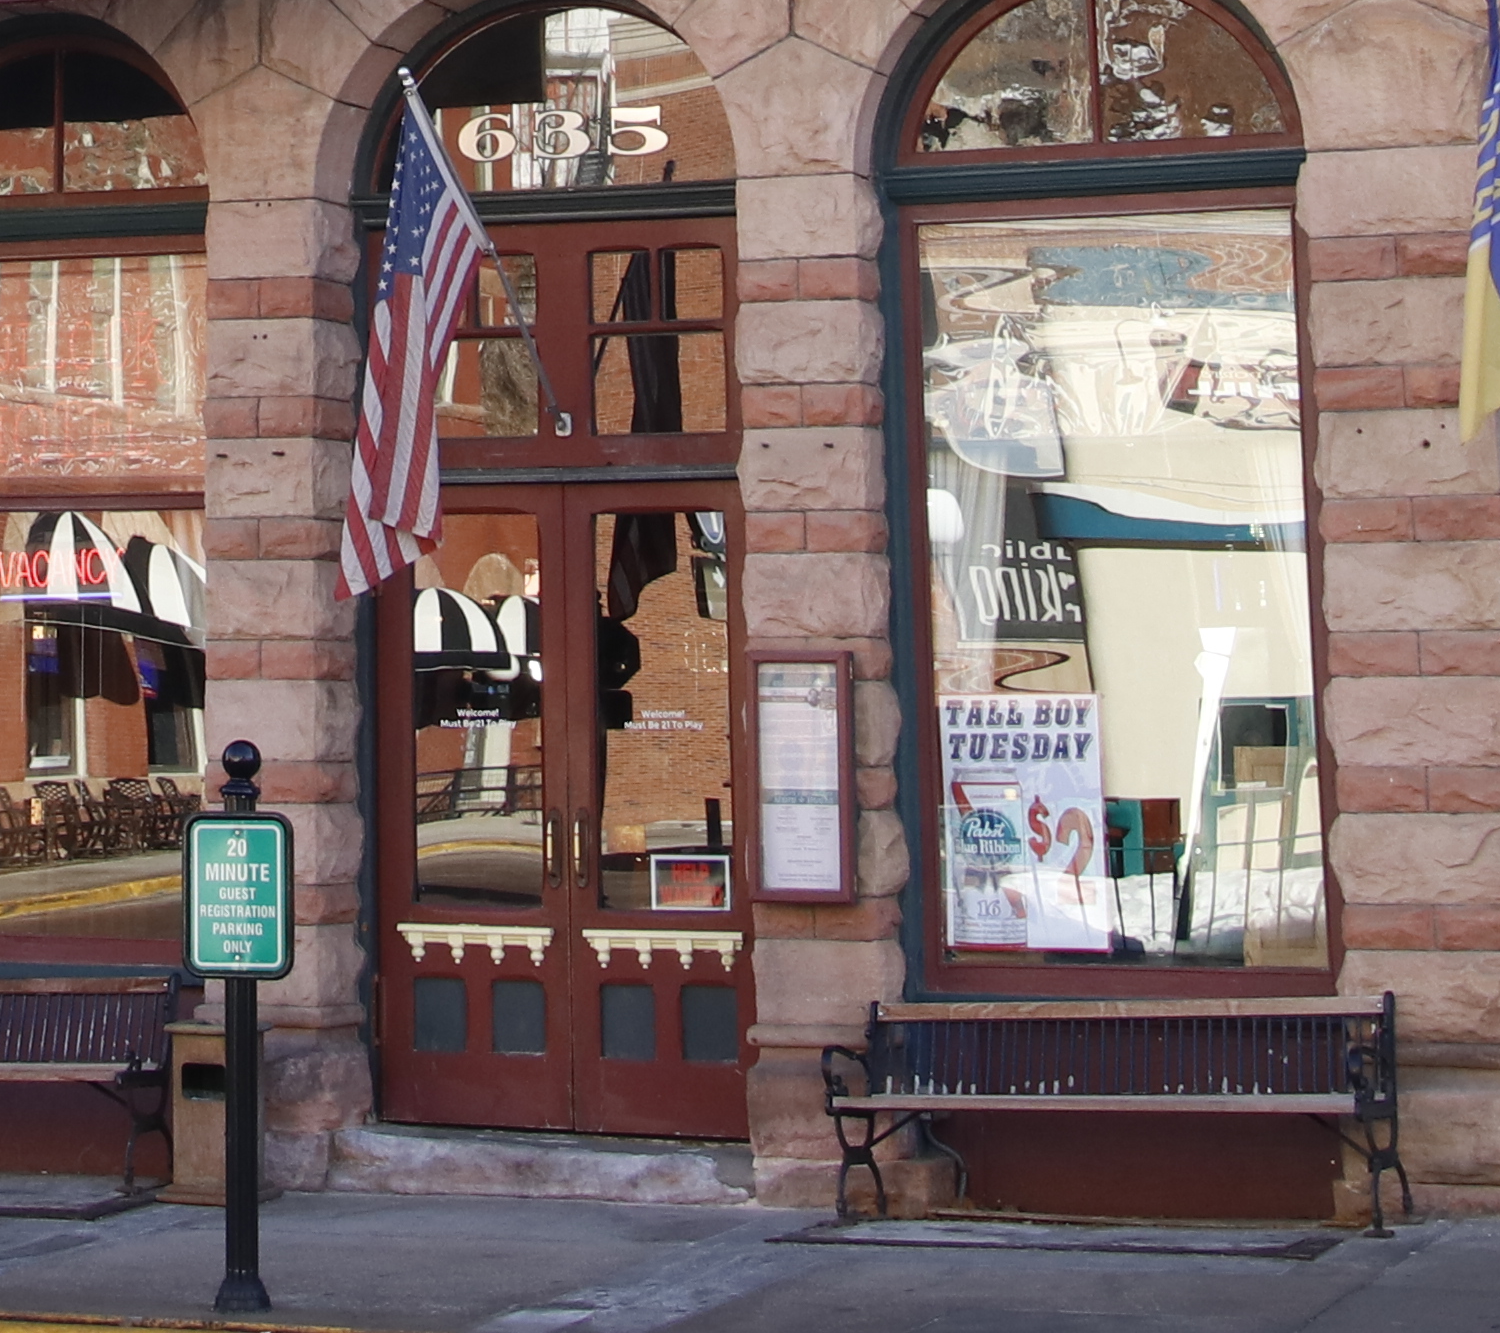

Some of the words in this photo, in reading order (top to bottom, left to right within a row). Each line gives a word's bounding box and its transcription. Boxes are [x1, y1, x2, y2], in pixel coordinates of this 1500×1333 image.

[457, 105, 670, 163] 635
[456, 707, 500, 717] Welcome!
[641, 709, 686, 719] Welcome!
[945, 699, 1023, 728] TALL
[1032, 699, 1092, 728] BOY
[440, 719, 462, 728] Must
[462, 719, 475, 728] Be
[475, 719, 485, 728] 21
[485, 719, 497, 728] To
[623, 720, 646, 729] Must
[647, 720, 660, 729] Be
[661, 720, 670, 729] 21
[671, 720, 683, 729] To
[684, 720, 704, 731] Play
[948, 732, 1093, 761] TUESDAY
[964, 816, 1007, 839] Pabst
[226, 838, 248, 858] 20
[979, 838, 1023, 855] Ribbon
[205, 862, 271, 883] MINUTE
[218, 887, 257, 900] GUEST
[199, 904, 276, 918] REGISTRATION
[976, 898, 1001, 917] 16
[212, 921, 264, 936] PARKING
[222, 939, 253, 953] ONLY
